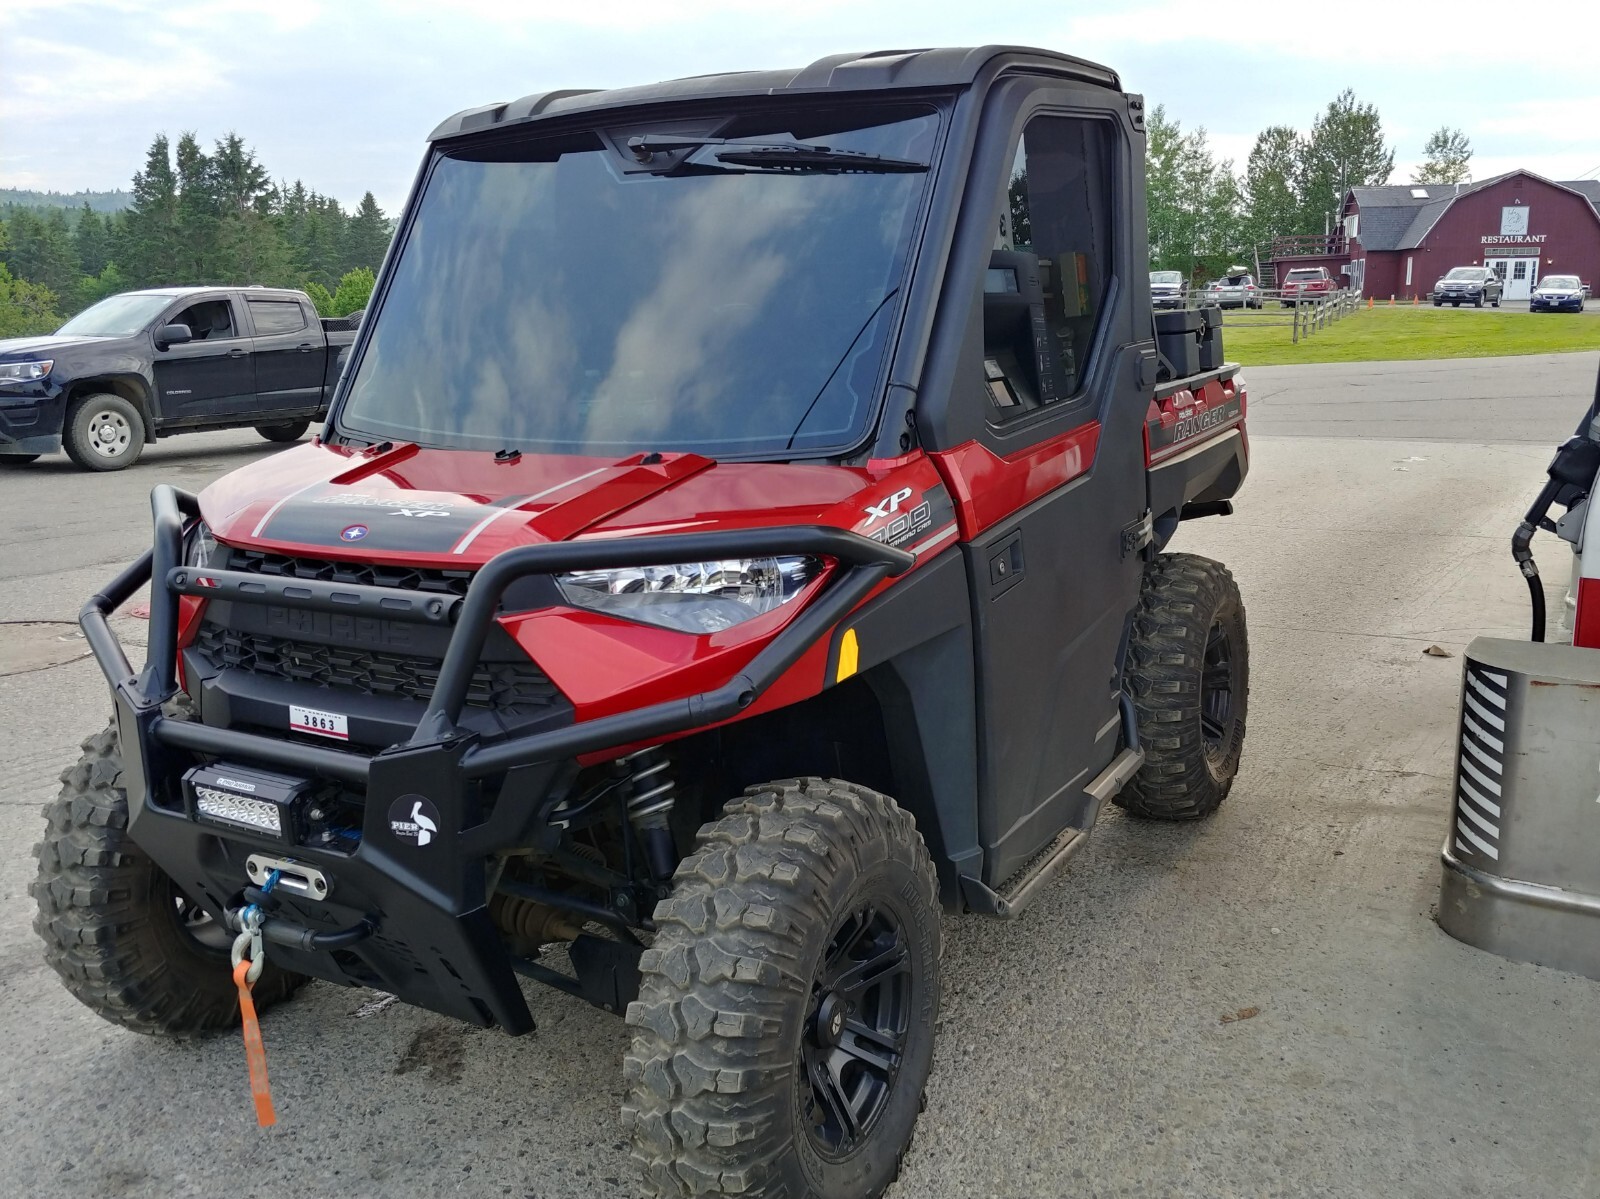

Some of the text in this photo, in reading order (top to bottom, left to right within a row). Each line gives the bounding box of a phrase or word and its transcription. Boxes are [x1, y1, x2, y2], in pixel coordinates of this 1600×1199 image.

[1481, 234, 1547, 244] RESTAURANT
[1173, 404, 1225, 443] RANGER
[386, 508, 451, 518] XP
[863, 486, 913, 527] XP
[265, 603, 415, 647] POLARIS
[304, 714, 335, 731] 3863
[391, 820, 419, 831] PIER
